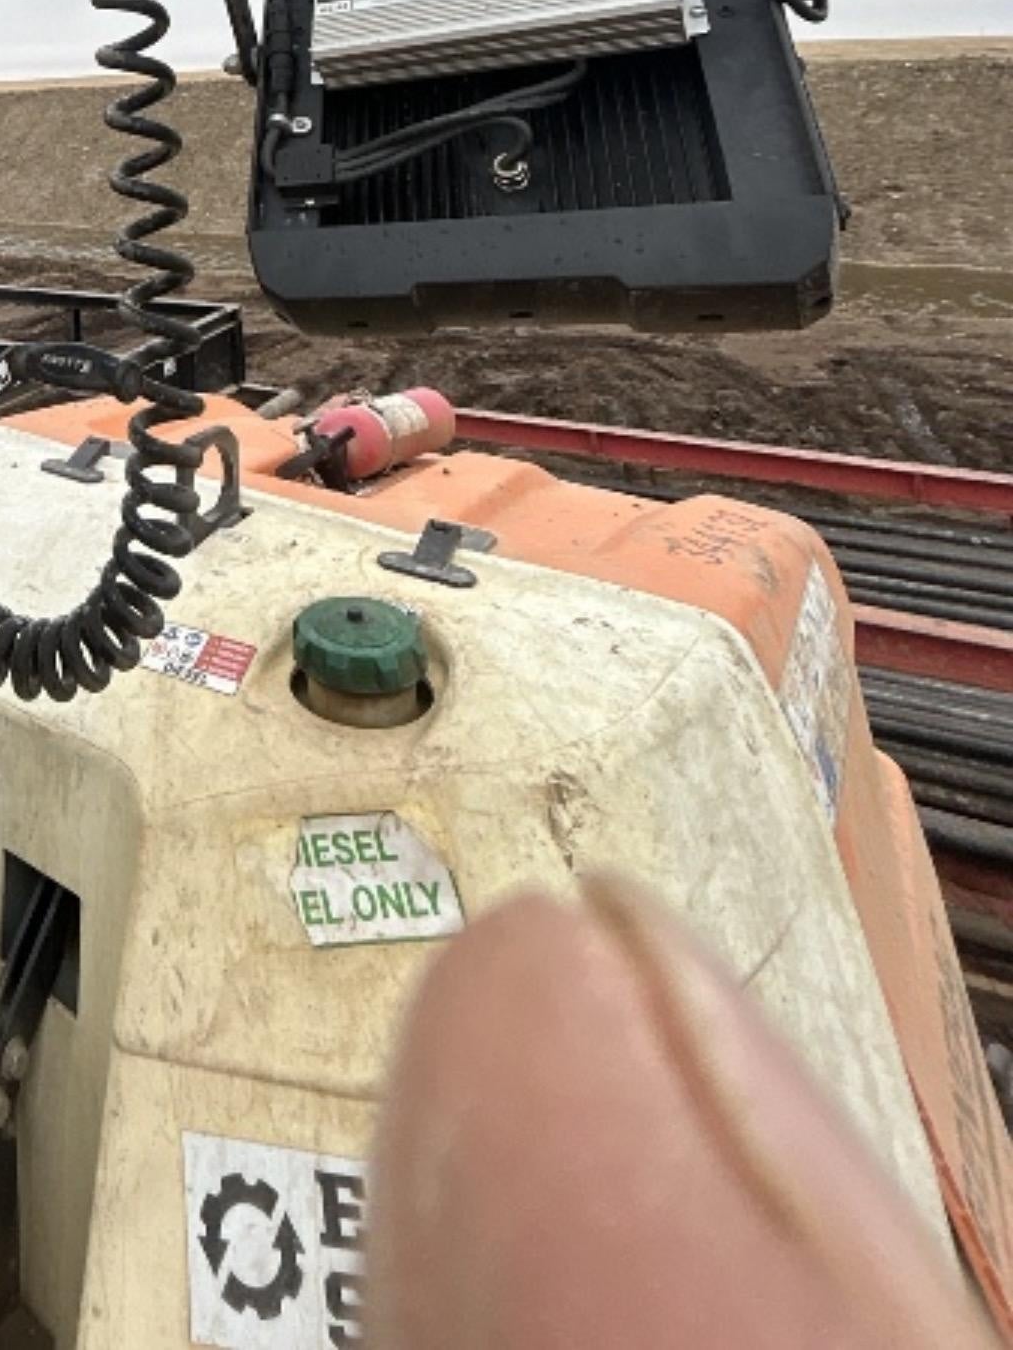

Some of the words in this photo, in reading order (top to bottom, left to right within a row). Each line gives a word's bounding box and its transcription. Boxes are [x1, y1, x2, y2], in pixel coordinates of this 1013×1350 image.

[297, 830, 398, 868] IESEL
[295, 888, 344, 925] EL
[352, 881, 441, 921] ONLY
